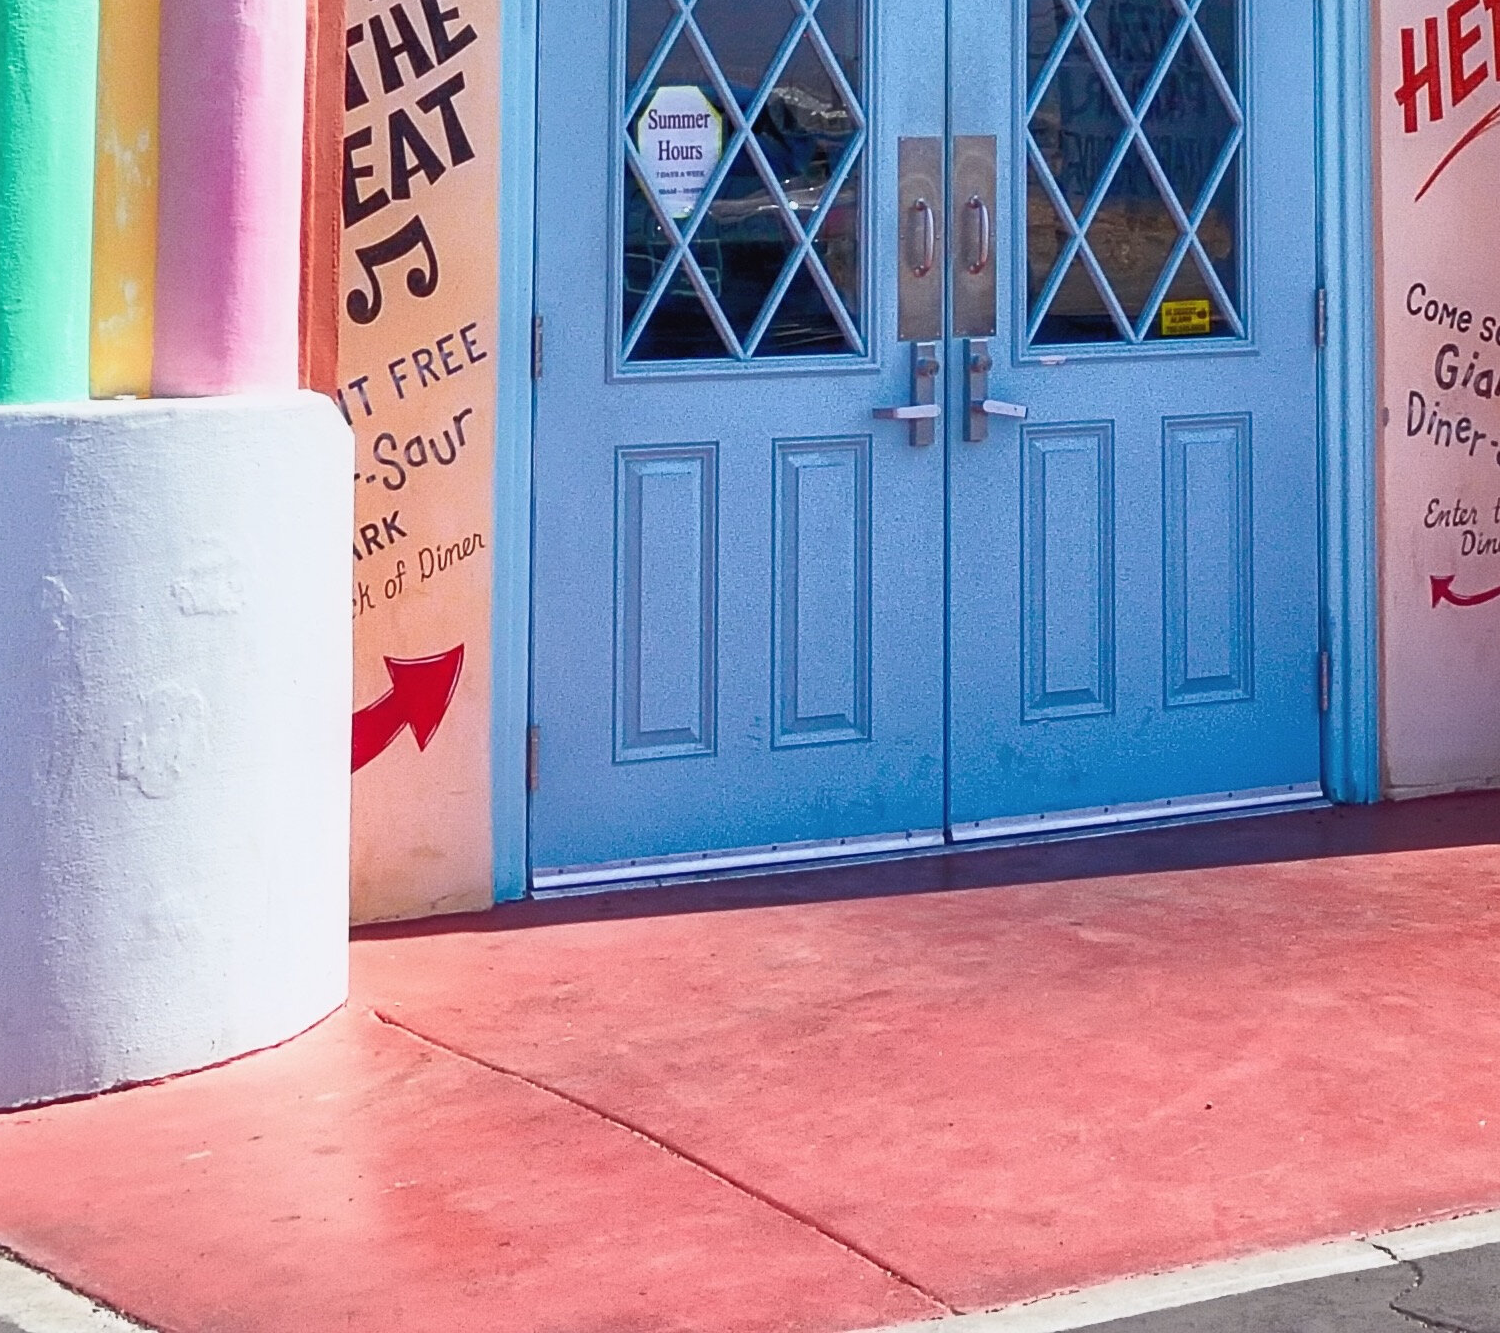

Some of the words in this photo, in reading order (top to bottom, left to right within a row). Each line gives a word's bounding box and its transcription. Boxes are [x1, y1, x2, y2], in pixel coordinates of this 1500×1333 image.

[647, 108, 711, 130] Summer
[657, 139, 703, 161] Hours
[387, 322, 488, 401] FREE
[1423, 497, 1478, 529] Enter
[384, 559, 407, 600] of
[418, 532, 486, 583] Diner
